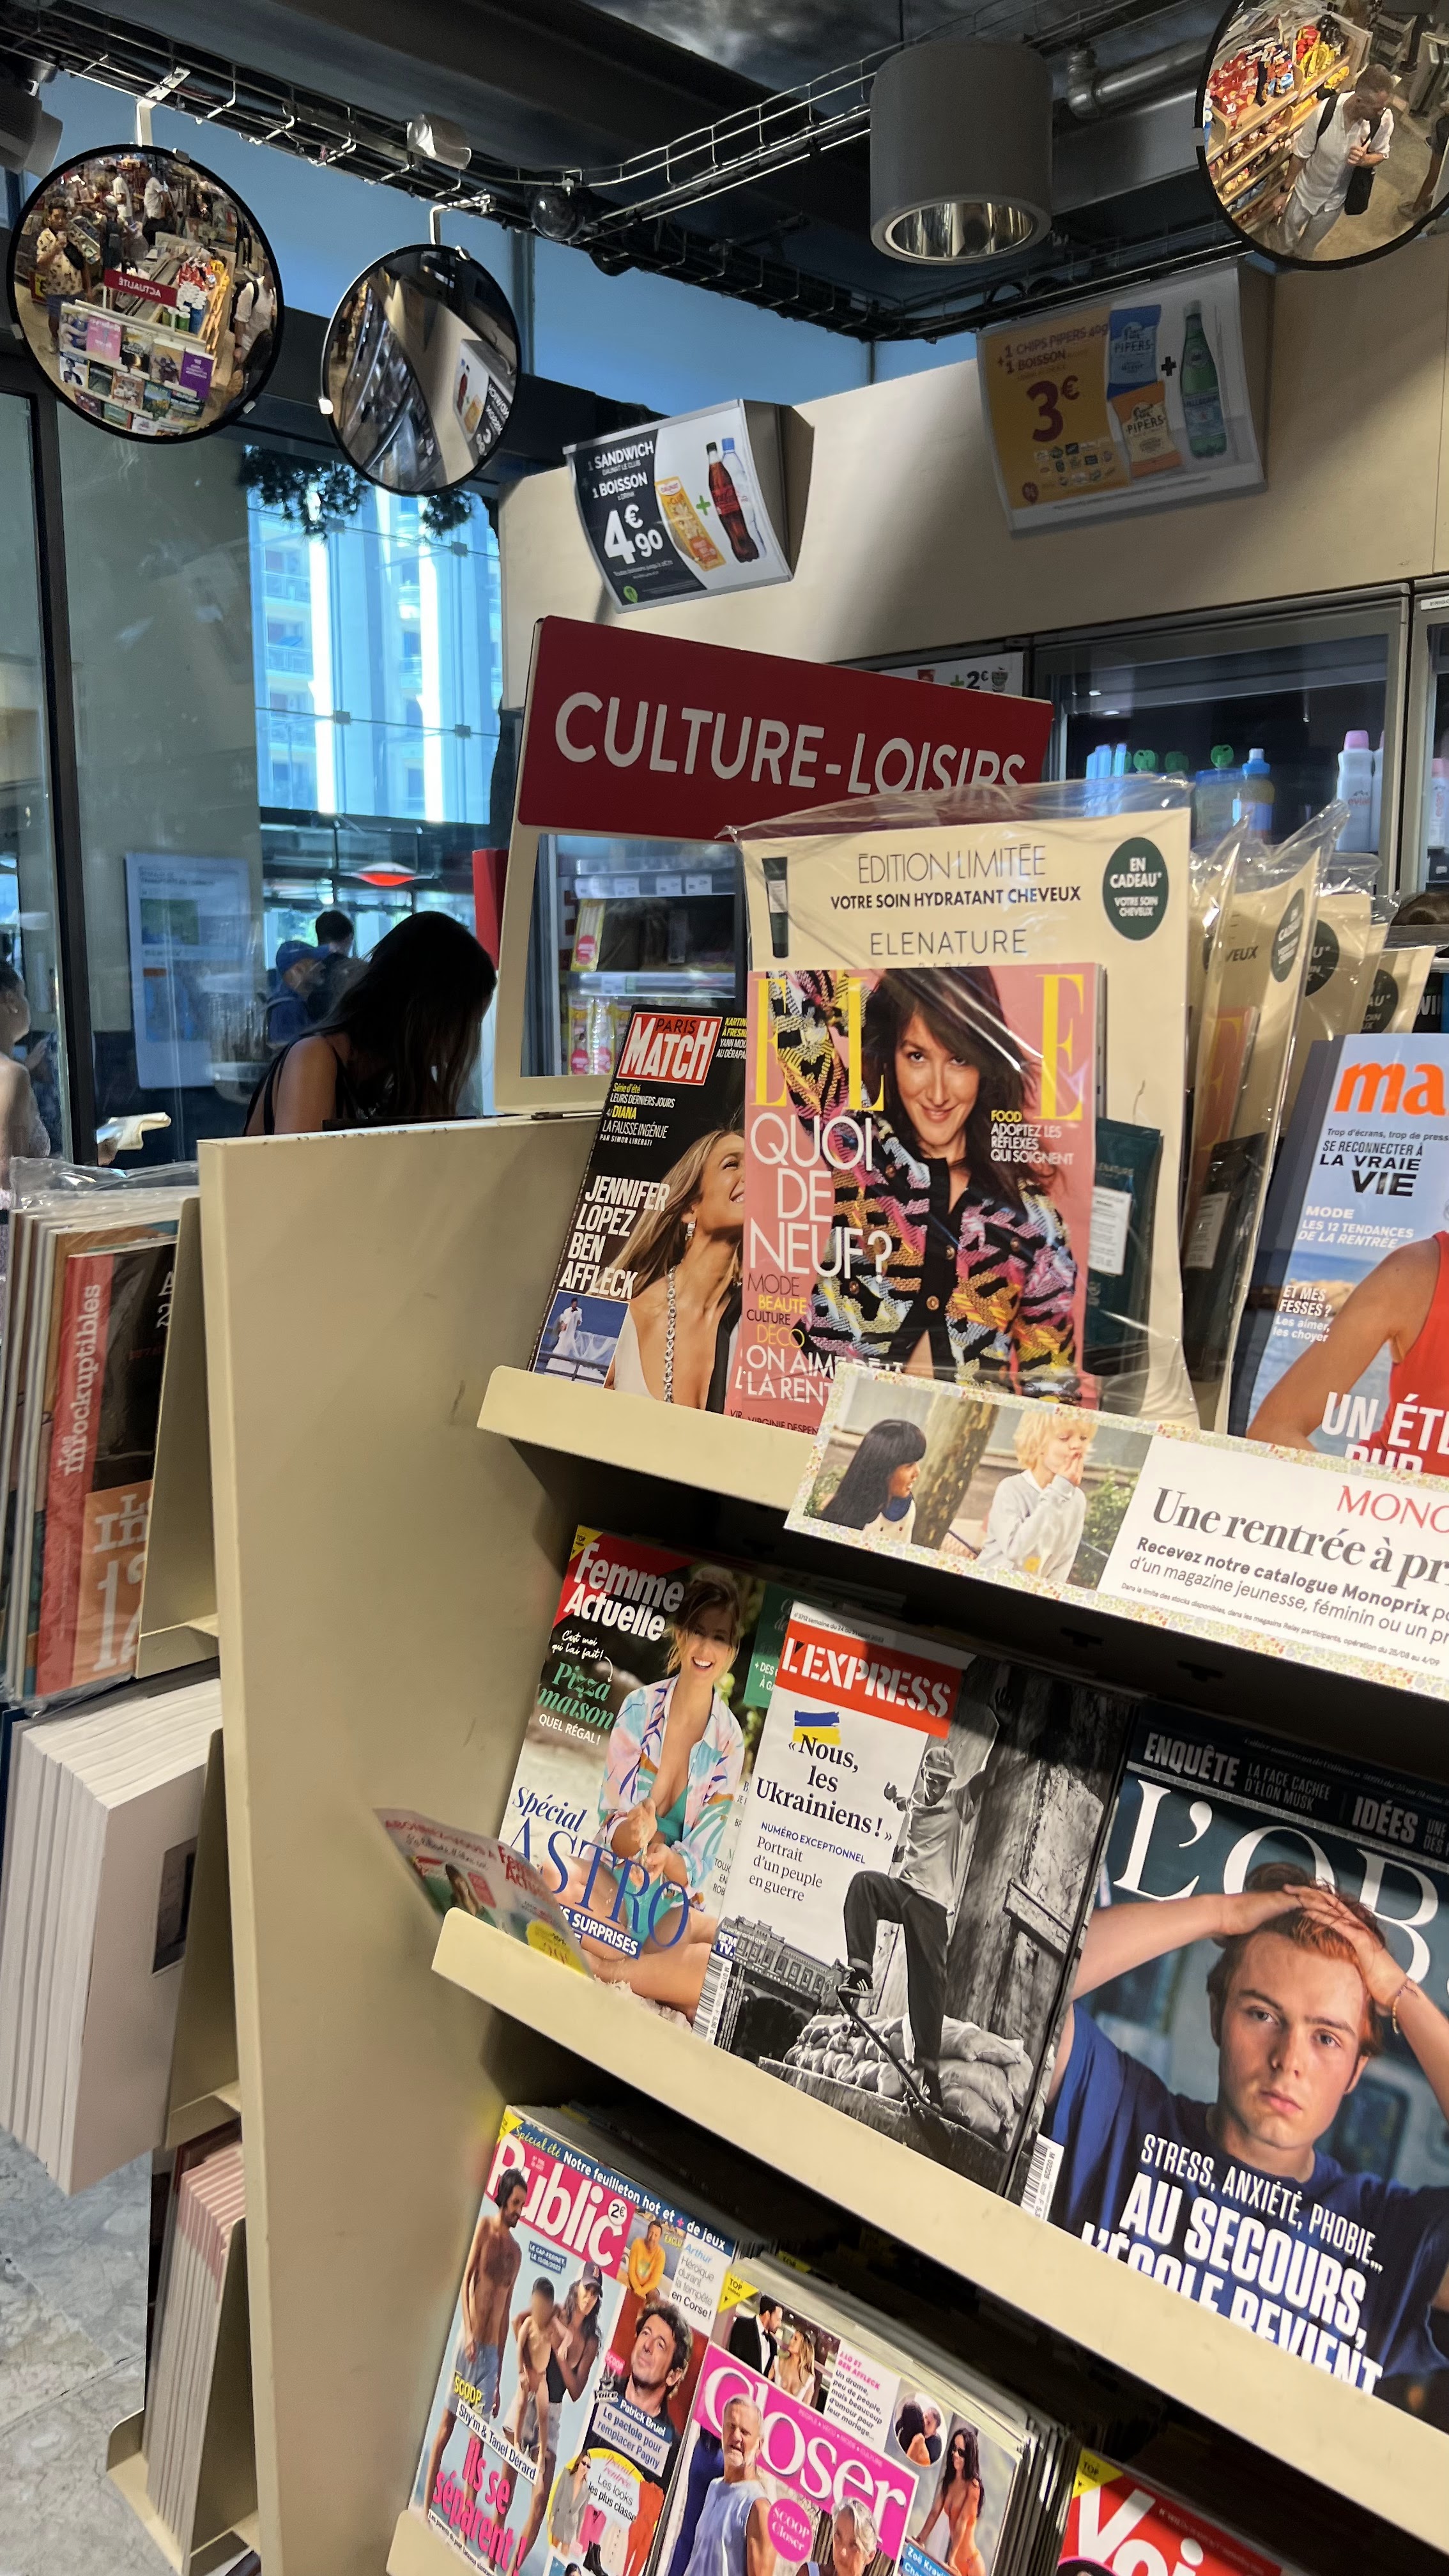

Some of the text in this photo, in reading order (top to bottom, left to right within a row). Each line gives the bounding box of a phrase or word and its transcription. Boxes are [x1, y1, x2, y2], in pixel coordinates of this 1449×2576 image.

[1016, 337, 1048, 356] CHIPS
[1048, 326, 1087, 348] PIPERS
[1018, 349, 1066, 371] BOISSON
[1127, 416, 1165, 435] PIPERS
[594, 441, 654, 470] SANDWICH
[599, 471, 648, 497] BOISSON
[555, 691, 1025, 795] CULTURE-LOISIRS
[859, 844, 1046, 884] ÉDITION LIMITÉE
[1130, 857, 1146, 872] EN
[831, 885, 1081, 910] VOTRE SOIN HYDRATANT CHEVEUX
[1114, 896, 1158, 907] VOTRE SOIN
[1119, 907, 1153, 917] CHEVEUX
[871, 929, 1027, 956] ELENATURE
[655, 1018, 697, 1034] PARIS
[621, 1016, 717, 1080] MATCH
[610, 1093, 675, 1108] LEURS DERNIERS JOURS
[612, 1105, 637, 1120] DIANA
[602, 1119, 639, 1136] LA FAUSSE
[990, 1122, 1062, 1138] ADOPTEZ LES
[991, 1110, 1022, 1123] FOOD
[611, 1135, 629, 1144] SIMON
[629, 1137, 652, 1146] LIBERATI
[751, 1112, 873, 1172] QUOI
[1322, 1140, 1413, 1156] SE RECONNECTER
[1328, 1128, 1345, 1137] Trop
[1347, 1129, 1386, 1138] d'écrans,
[1389, 1131, 1407, 1140] trop
[990, 1149, 1074, 1165] QUI SOIGNENT
[1320, 1154, 1422, 1171] LA VRAIE
[585, 1176, 670, 1211] JENNIFER
[778, 1168, 832, 1222] DE
[1351, 1170, 1417, 1197] VIE
[576, 1203, 636, 1237] LOPEZ
[1305, 1206, 1354, 1220] MODE
[1298, 1230, 1399, 1248] DE LA RENTRÉE
[1303, 1220, 1414, 1238] LES 12 TENDANCES
[568, 1232, 606, 1263] BEN
[558, 1261, 639, 1300] AFFLECK
[747, 1273, 800, 1296] MODE
[1282, 1285, 1326, 1302] ET MES
[746, 1309, 790, 1326] CULTURE
[1275, 1315, 1330, 1333] Les aimer,
[1272, 1326, 1329, 1343] les choyer
[746, 1344, 785, 1372] ON
[65, 1284, 101, 1477] Inrockuptibles
[1321, 1392, 1379, 1441] UN
[1153, 1487, 1365, 1569] Une rentrée
[574, 1542, 685, 1613] Femme
[1137, 1537, 1430, 1617] Recevez notre catalogue Monoprix
[1130, 1556, 1428, 1639] d'un magazine jeunesse, féminin ou un
[563, 1583, 666, 1641] Actuelle
[1344, 1637, 1377, 1650] opération
[551, 1662, 612, 1702] Pizza
[781, 1637, 951, 1718] L'EXPRESS
[537, 1683, 615, 1730] maison
[539, 1713, 563, 1733] QUEL
[799, 1733, 859, 1773] Nous,
[1144, 1732, 1240, 1788] ENQUÊTE
[1264, 1768, 1289, 1788] FACE
[1292, 1774, 1332, 1800] CACHÉE
[807, 1765, 838, 1792] les
[512, 1786, 588, 1833] Spécial
[756, 1777, 872, 1834] Ukrainiens
[1245, 1779, 1314, 1812] D'ELON MUSK
[1352, 1795, 1418, 1844] IDÉES
[756, 1836, 804, 1862] Portrait
[761, 1821, 866, 1864] NUMÉRO EXCEPTIONNEL
[753, 1854, 823, 1888] d'un peuple
[749, 1874, 763, 1887] en
[763, 1881, 804, 1901] guerre
[572, 1907, 639, 1956] SURPRISES
[719, 1931, 737, 1946] BFM
[1141, 2133, 1216, 2191] STRESS,
[1222, 2166, 1303, 2230] ANXIÉTÉ,
[487, 2132, 624, 2267] Public
[564, 2151, 591, 2176] Notre
[593, 2168, 641, 2204] feuilleton
[642, 2196, 661, 2214] hot
[663, 2207, 675, 2223] et
[687, 2221, 701, 2235] de
[701, 2227, 726, 2251] jeux
[685, 2243, 713, 2264] Arthur
[1119, 2172, 1184, 2246] AU
[1184, 2196, 1368, 2351] SECOURS,
[678, 2267, 702, 2288] durant
[730, 2278, 742, 2290] TOP
[671, 2290, 682, 2302] en
[832, 2379, 856, 2397] peu de
[836, 2369, 845, 2380] Un
[454, 2375, 482, 2406] SCOOP
[620, 2399, 666, 2437] Patrick Bruel
[827, 2405, 841, 2419] leur
[831, 2389, 847, 2402] mais
[849, 2399, 882, 2425] beaucoup
[602, 2406, 663, 2453] Le pactole pour
[858, 2414, 875, 2429] pour
[598, 2421, 660, 2471] remplacer Pagny
[704, 2365, 907, 2543] Closer
[463, 2437, 510, 2515] Ils se
[508, 2451, 537, 2480] Dérard
[588, 2482, 613, 2510] les plus
[597, 2473, 611, 2491] Les
[433, 2470, 514, 2572] séparent
[773, 2507, 810, 2539] SCOOP
[771, 2521, 805, 2551] Closer
[907, 2545, 923, 2564] Zoë
